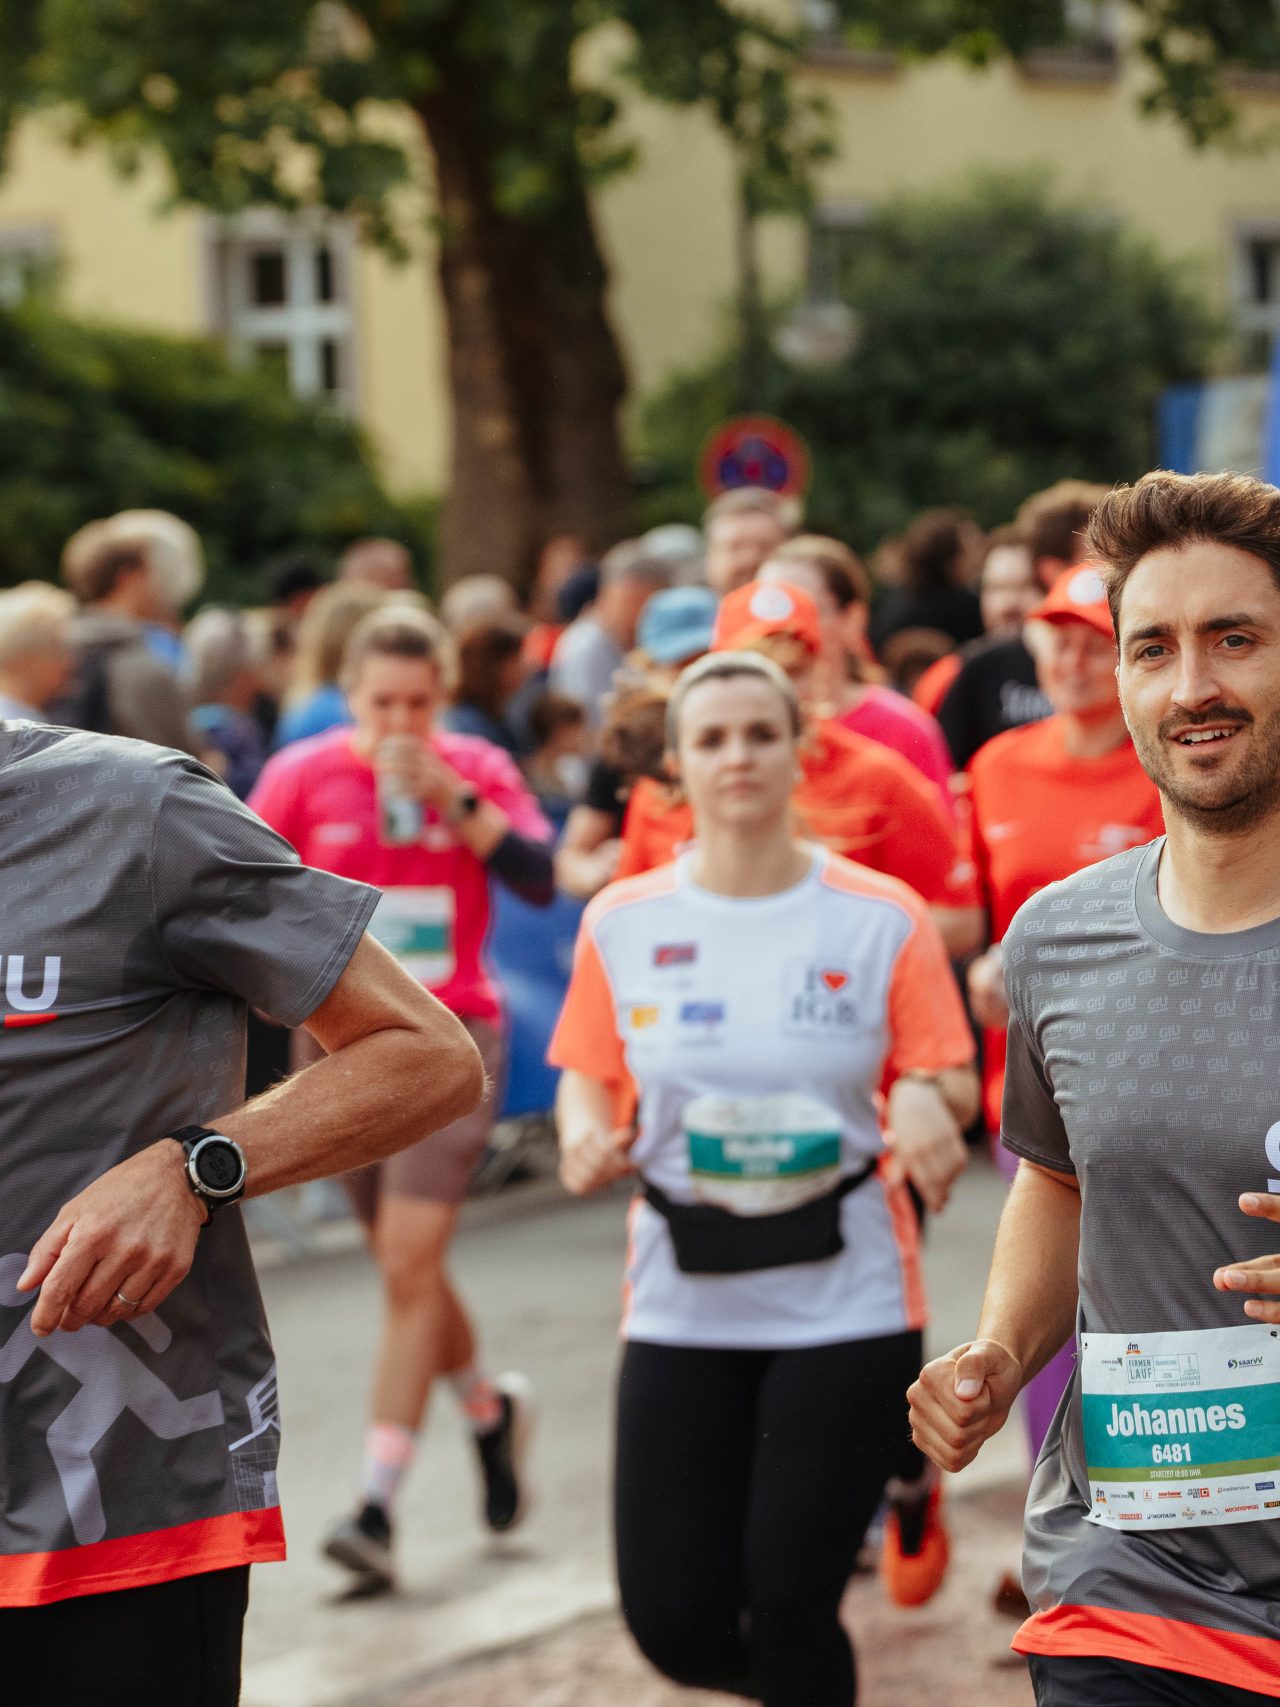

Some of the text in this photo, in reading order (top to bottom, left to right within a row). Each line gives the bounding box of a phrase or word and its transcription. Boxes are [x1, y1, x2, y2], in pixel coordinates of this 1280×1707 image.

[0, 956, 61, 1011] U
[1127, 1342, 1139, 1350] dm
[1128, 1359, 1151, 1367] FIRMEN
[1130, 1368, 1152, 1379] LAUF
[1106, 1403, 1246, 1437] Johannes
[1152, 1443, 1191, 1463] 6481
